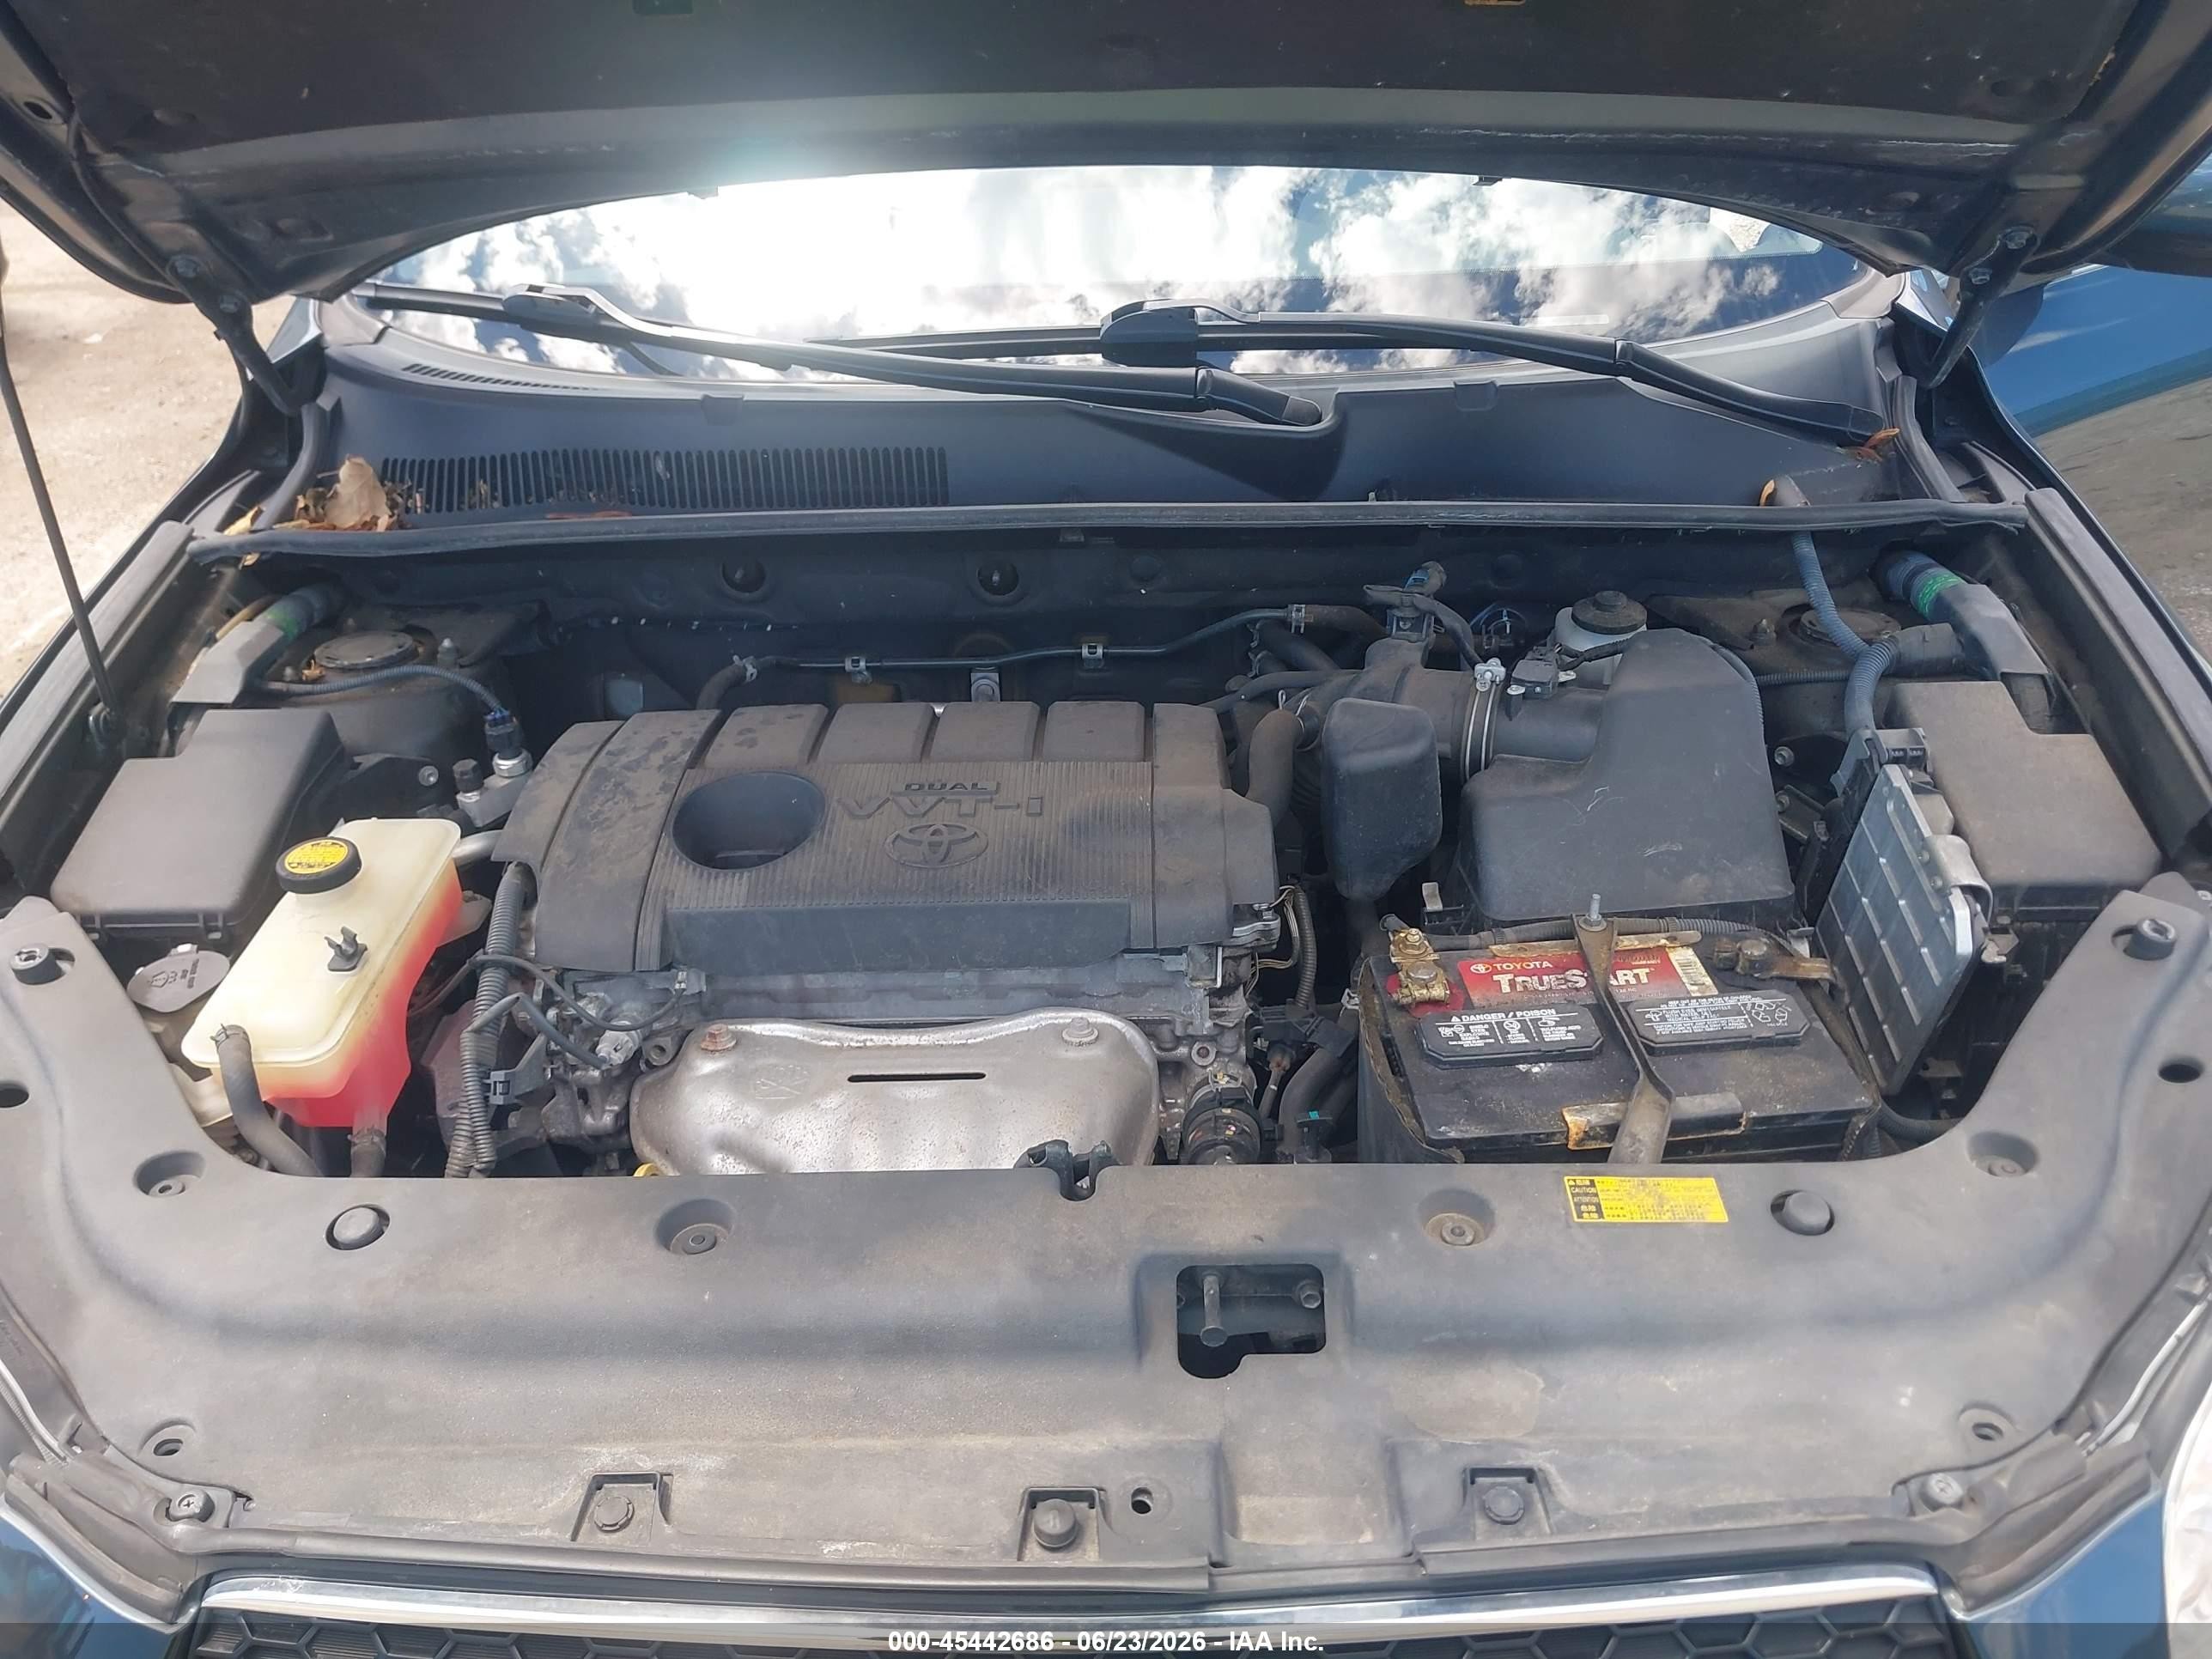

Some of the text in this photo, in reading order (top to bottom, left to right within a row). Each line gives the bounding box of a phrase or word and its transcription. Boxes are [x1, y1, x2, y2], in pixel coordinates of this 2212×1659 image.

[904, 782, 988, 791] DUAL
[1493, 961, 1553, 971] TOYOTA
[1462, 1012, 1506, 1022] DANGER
[1516, 1009, 1556, 1018] POISON
